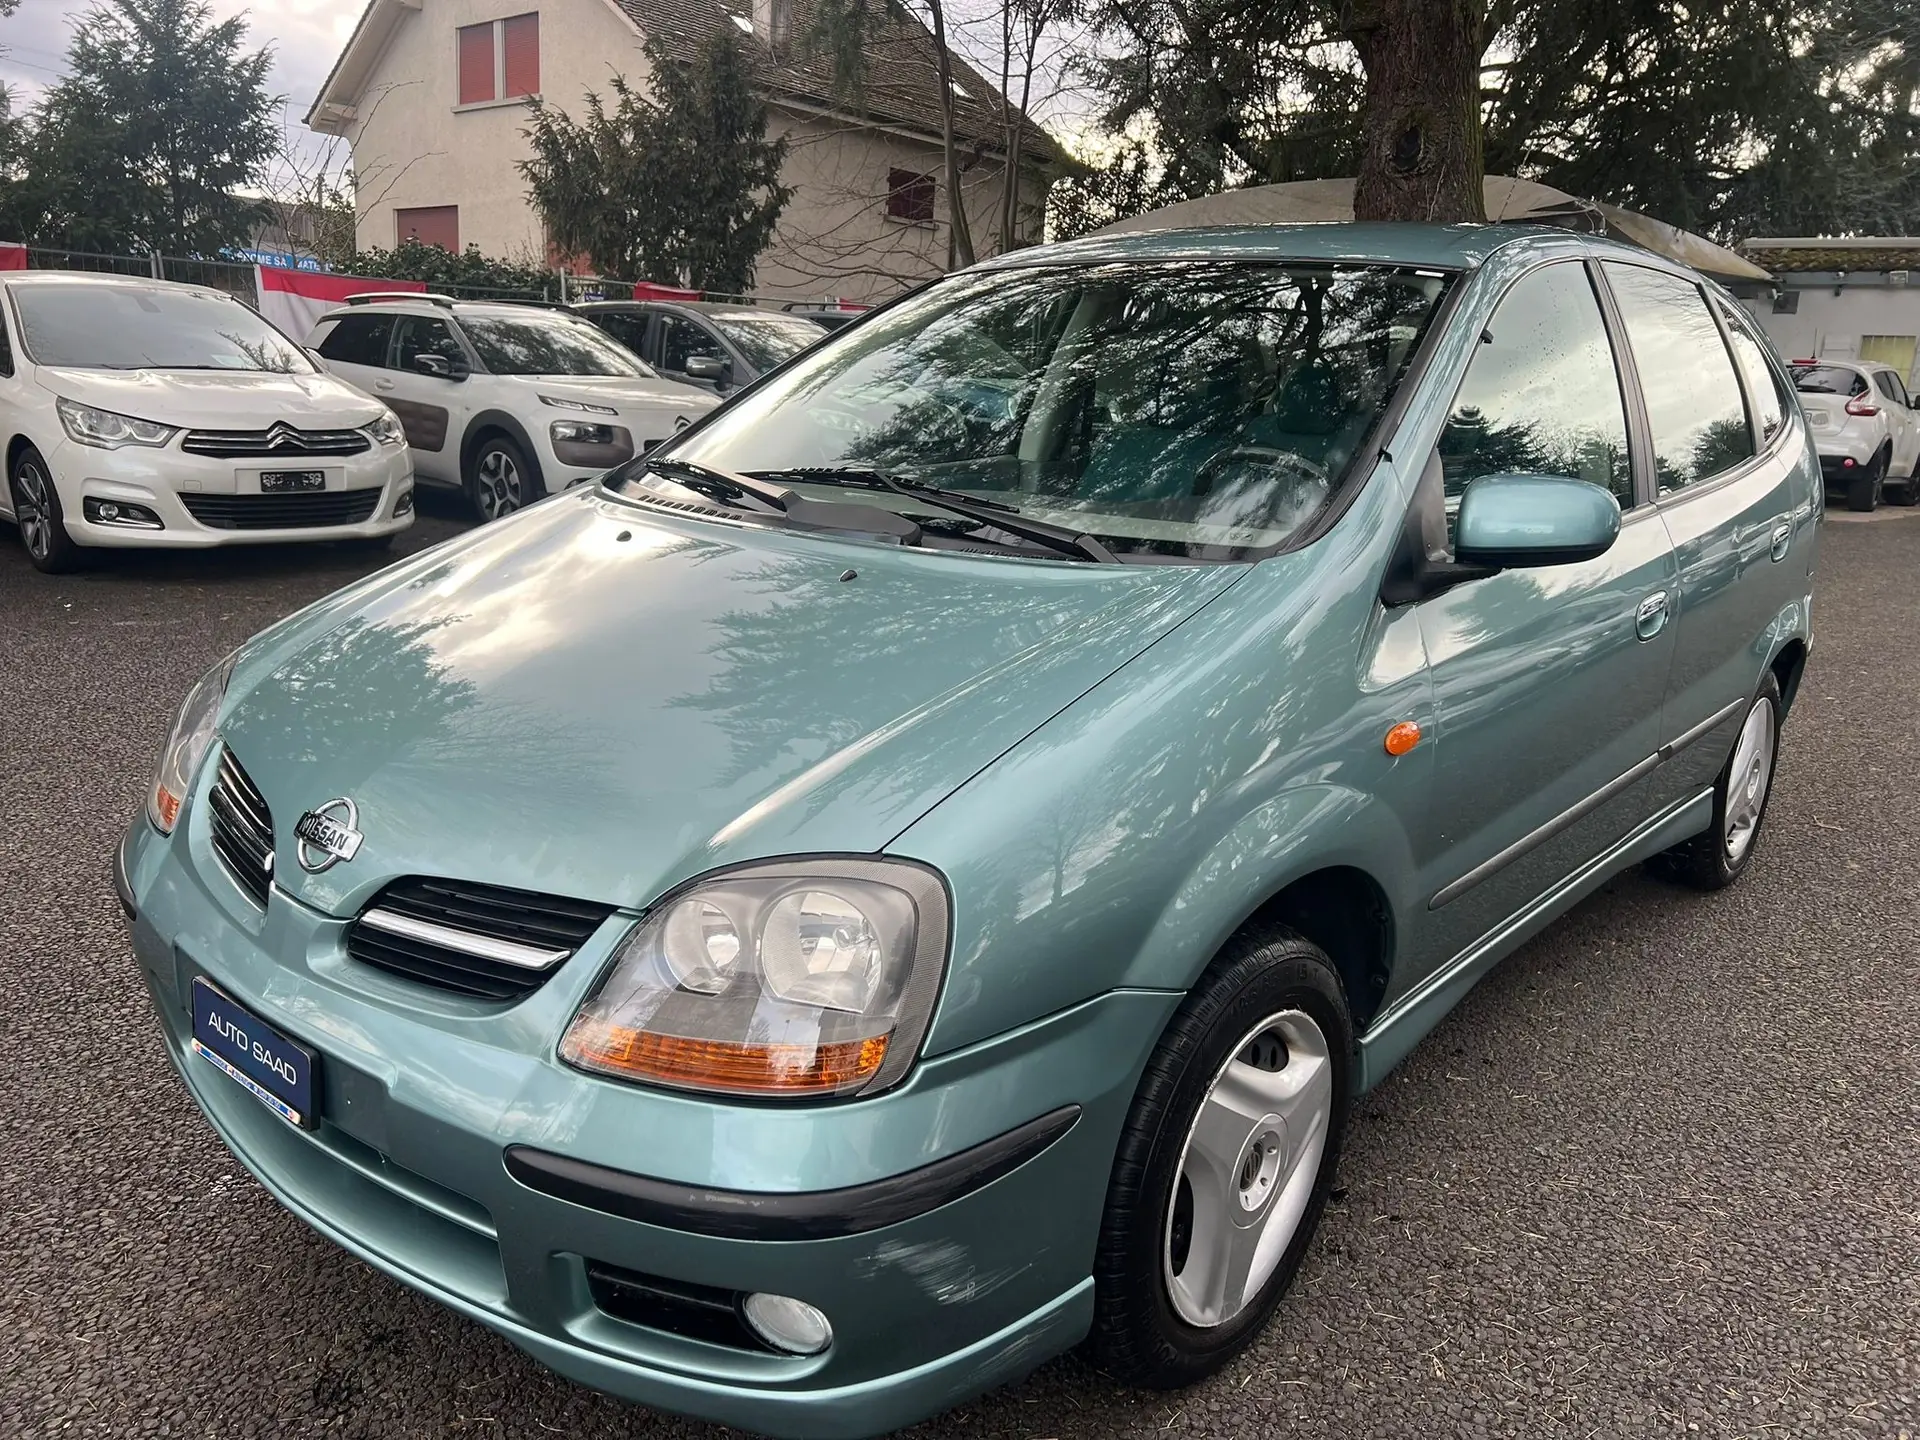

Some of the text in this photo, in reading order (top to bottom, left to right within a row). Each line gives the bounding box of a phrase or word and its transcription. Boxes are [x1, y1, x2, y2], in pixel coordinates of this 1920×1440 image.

[299, 816, 349, 850] NISSAN
[208, 1011, 248, 1051] AUTO
[252, 1041, 297, 1085] SAAD
